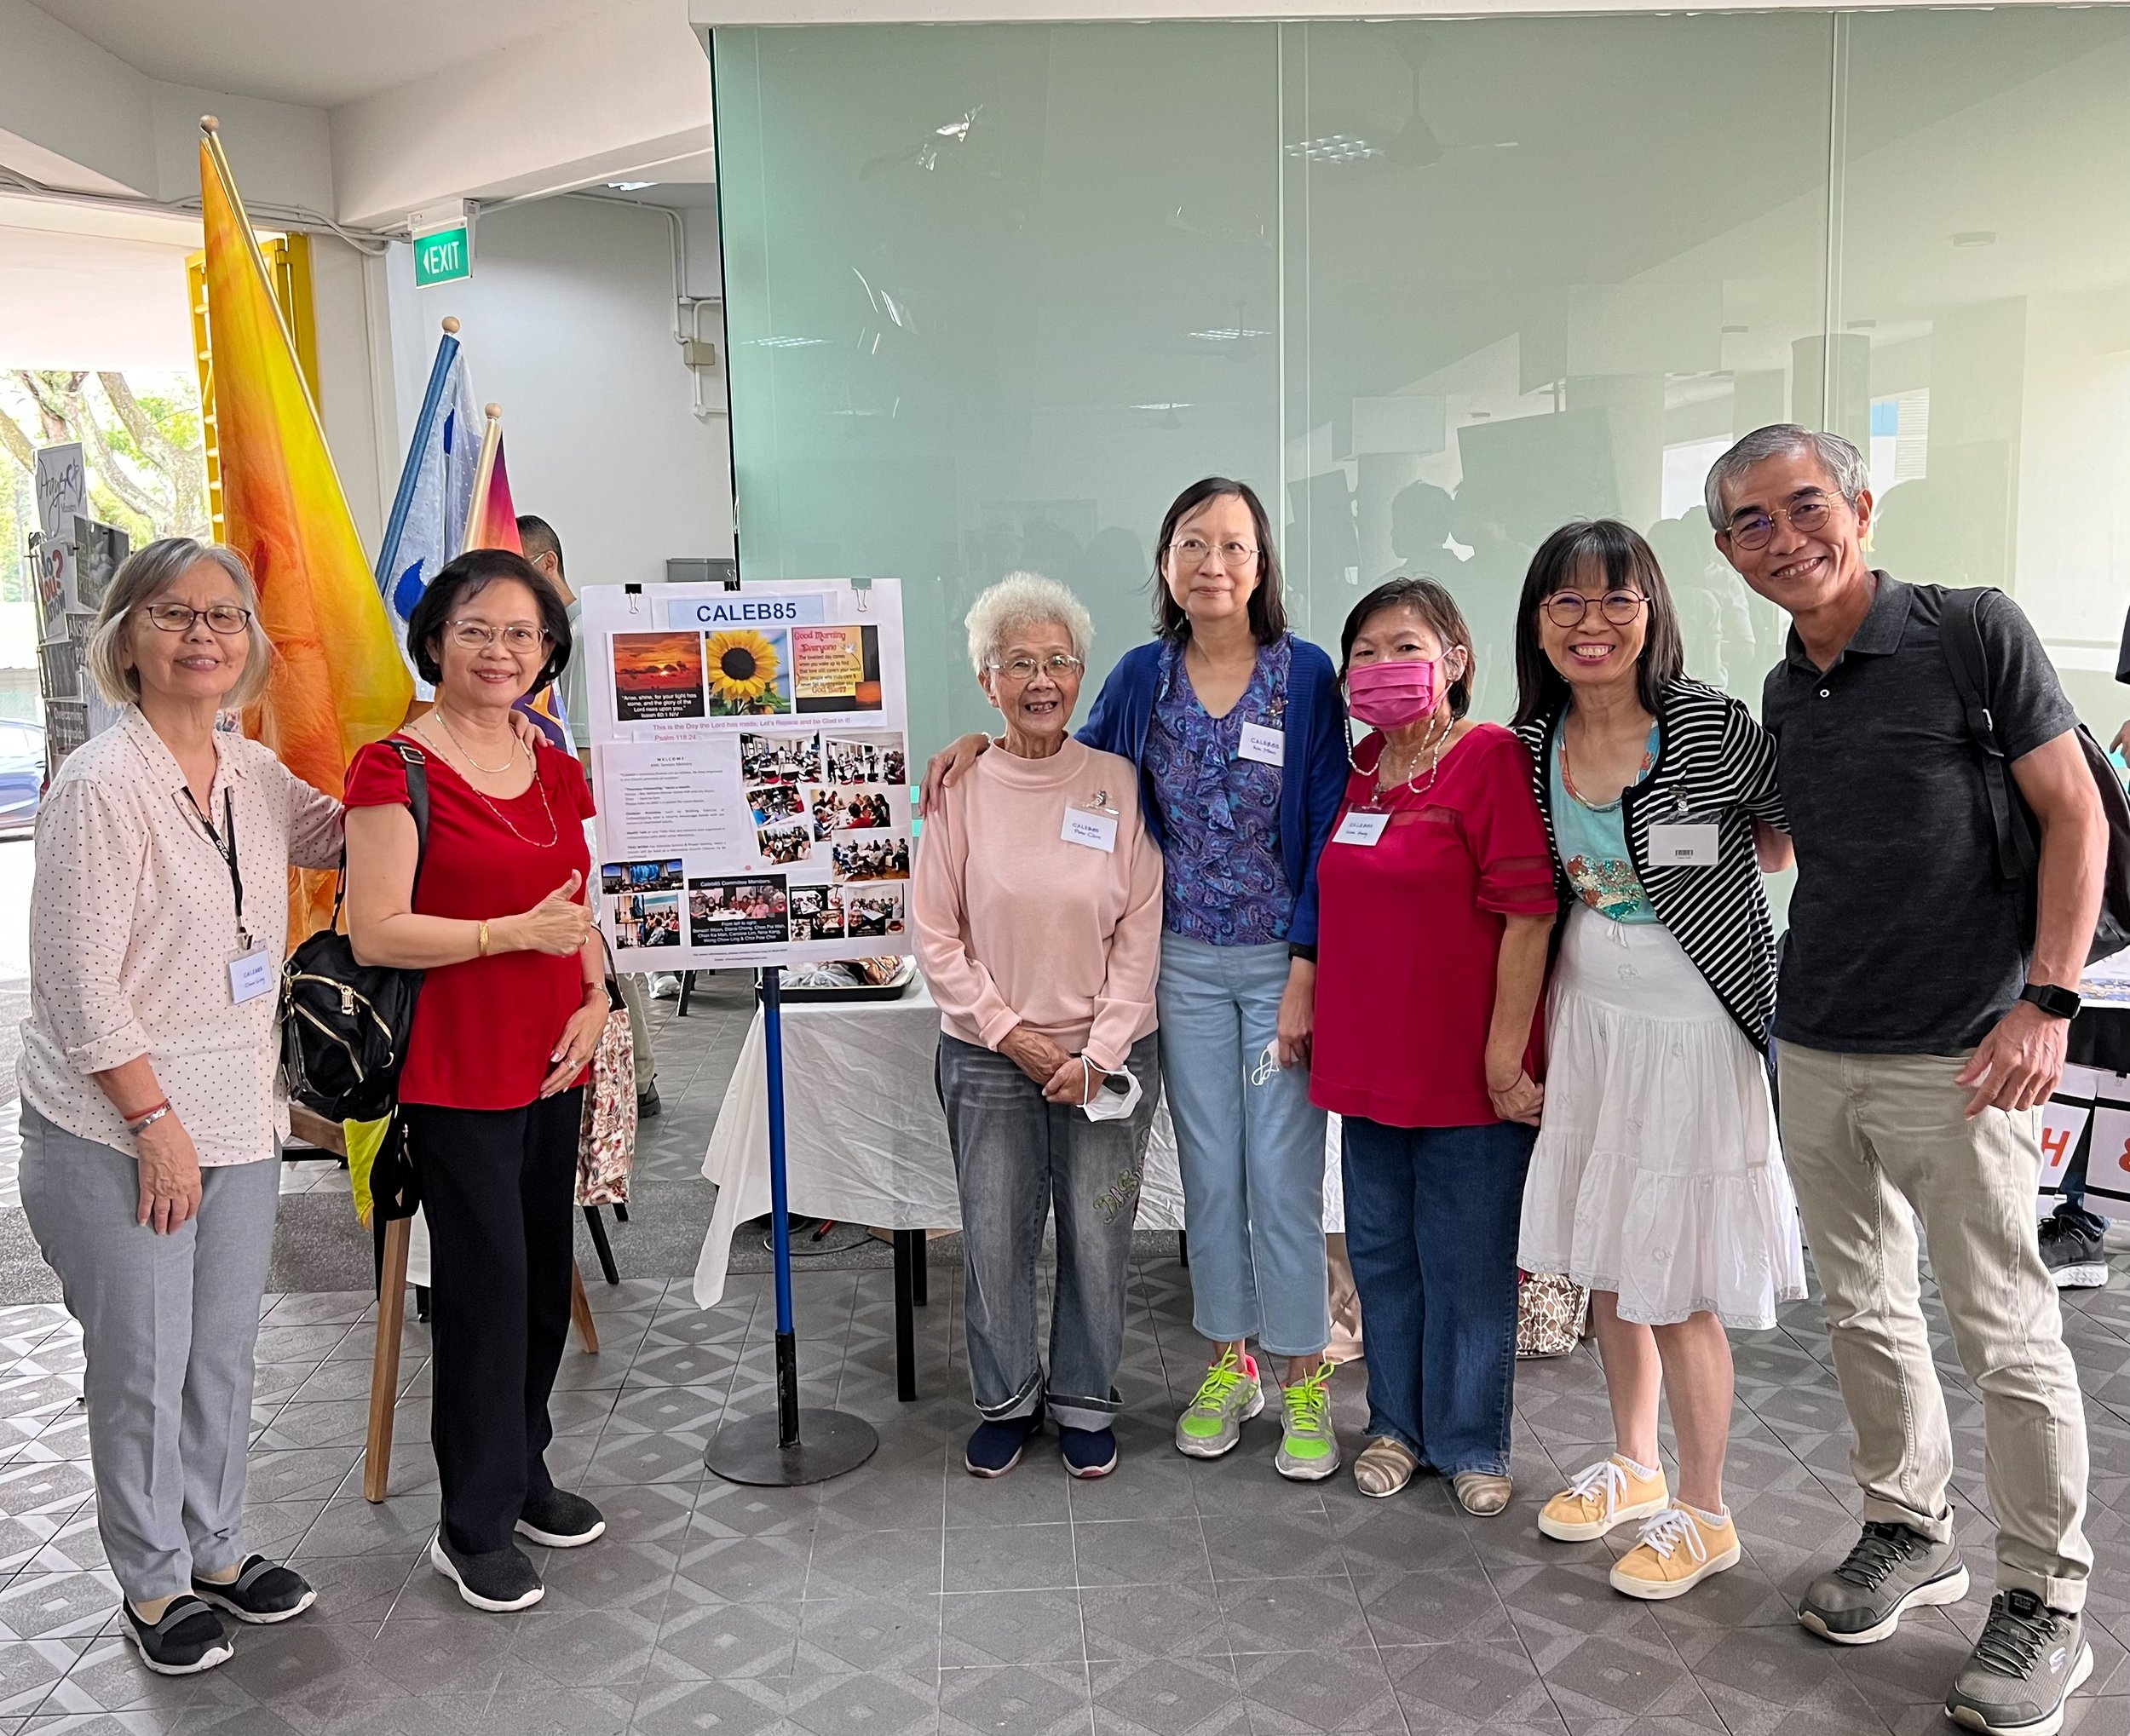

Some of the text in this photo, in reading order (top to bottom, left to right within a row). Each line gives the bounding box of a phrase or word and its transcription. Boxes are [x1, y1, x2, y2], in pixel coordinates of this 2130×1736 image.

[429, 241, 459, 274] EXIT
[696, 602, 797, 623] CALEB85
[794, 630, 846, 641] Good Morning
